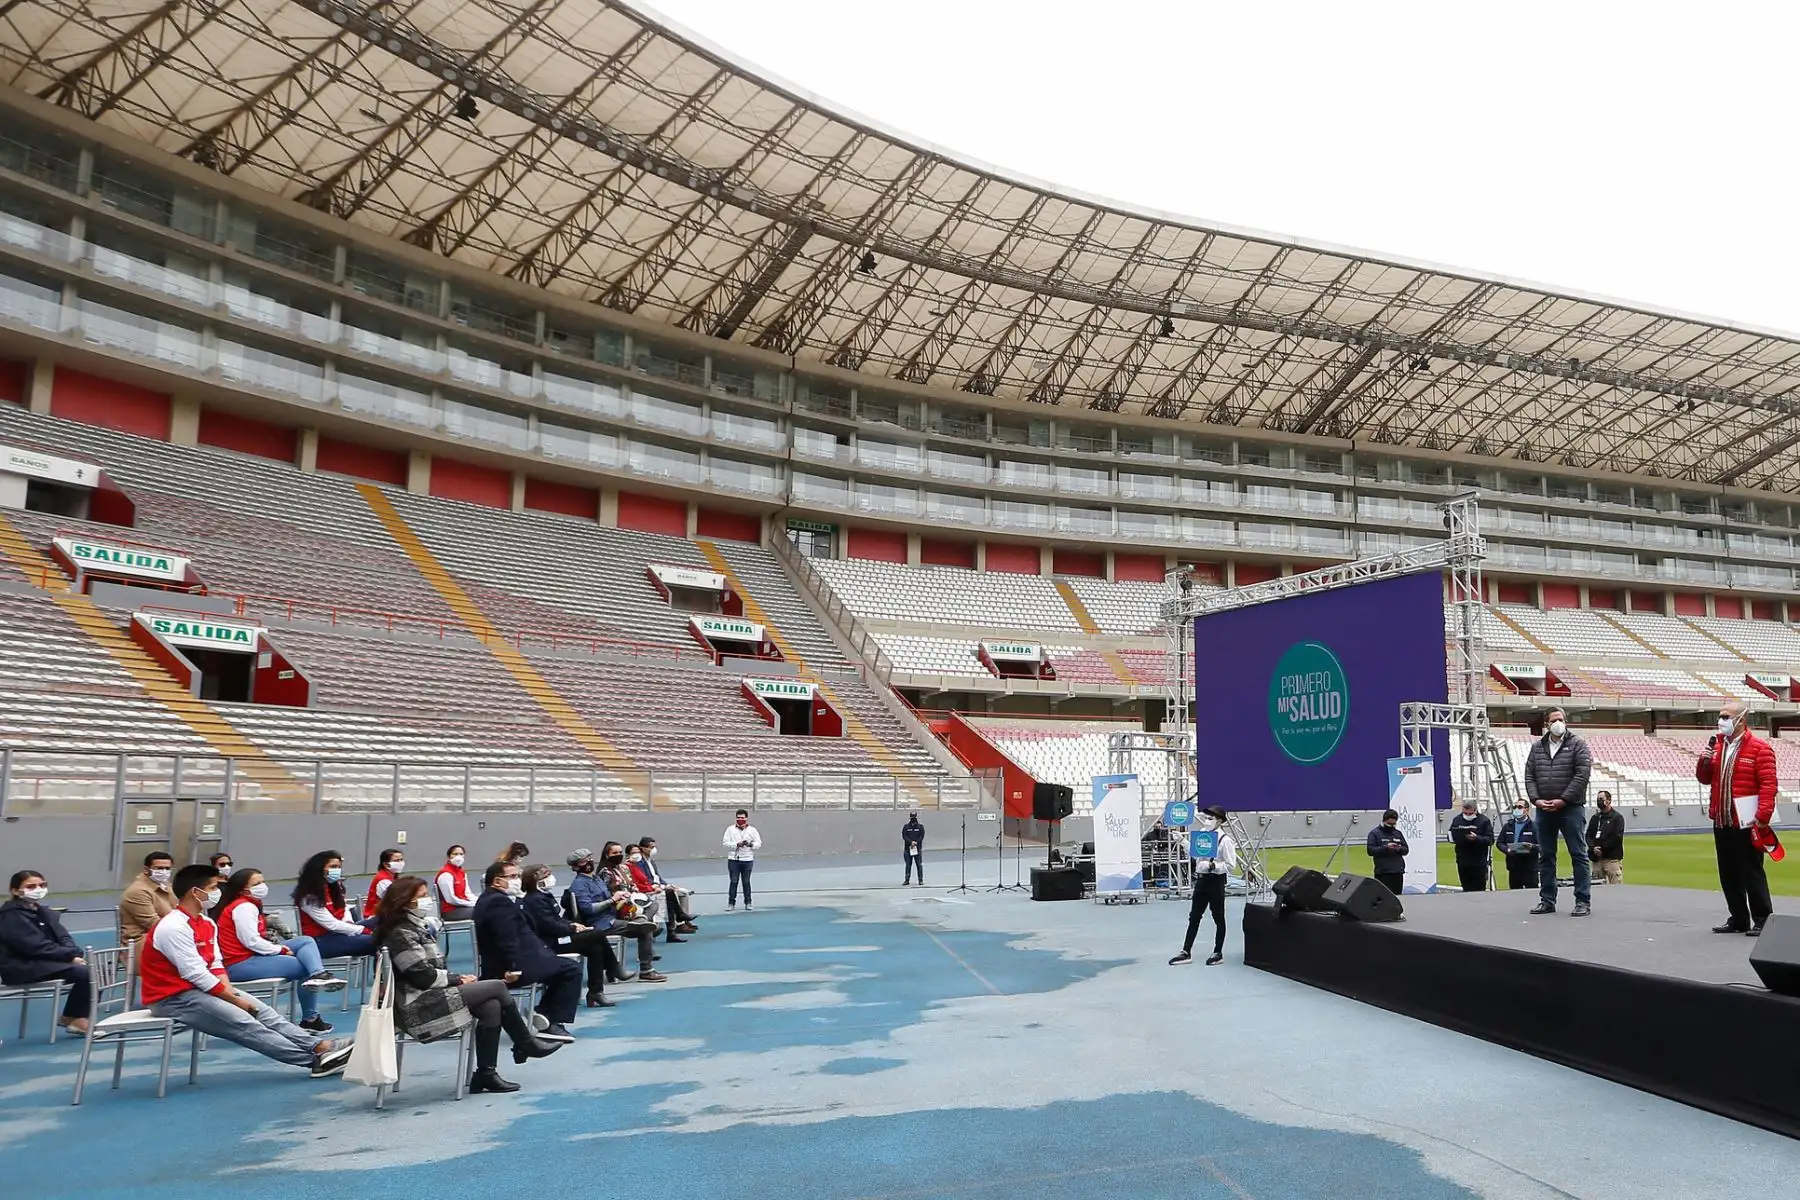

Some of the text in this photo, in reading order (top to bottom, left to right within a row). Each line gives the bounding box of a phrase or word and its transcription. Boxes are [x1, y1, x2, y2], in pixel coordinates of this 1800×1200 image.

[789, 520, 830, 531] SALIDA
[75, 545, 169, 570] SALIDA
[154, 620, 249, 642] SALIDA
[703, 621, 753, 634] SALIDA
[990, 645, 1032, 654] SALIDA
[755, 683, 808, 694] SALIDA
[1289, 691, 1341, 722] SALUD
[1104, 818, 1129, 826] SALUD
[1399, 813, 1424, 822] SALUD
[1401, 822, 1417, 830] NOS
[1406, 830, 1423, 838] UNE
